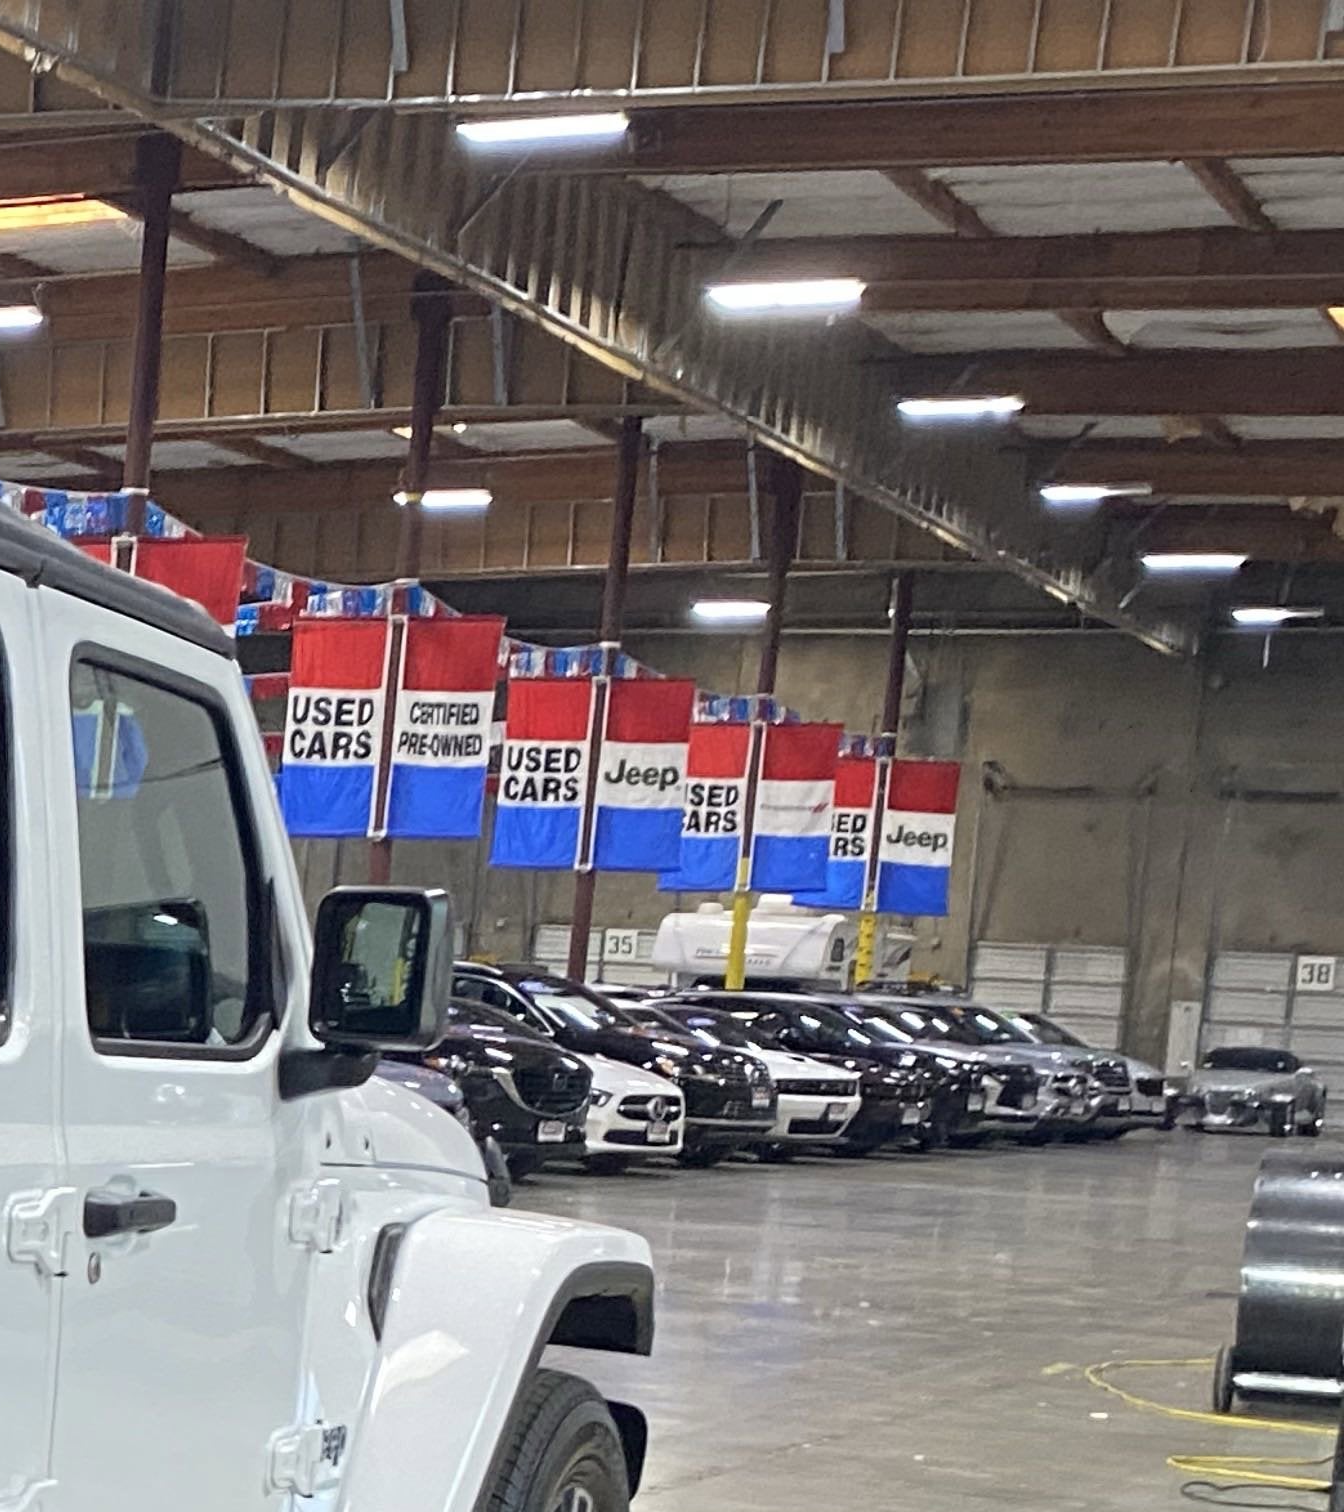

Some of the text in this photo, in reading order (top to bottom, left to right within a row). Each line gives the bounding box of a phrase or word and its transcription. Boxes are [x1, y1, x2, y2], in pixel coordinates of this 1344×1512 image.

[292, 695, 374, 726] USED
[410, 701, 480, 726] CERTIFIED
[289, 729, 372, 760] CARS
[398, 731, 482, 758] PRE-OWNED
[507, 746, 582, 774] USED
[503, 775, 579, 801] CARS
[604, 758, 680, 792] Jeep
[685, 783, 739, 808] SED
[685, 810, 737, 833] ARS
[886, 824, 949, 853] Jeep
[607, 935, 633, 955] 35
[1301, 963, 1332, 985] 38
